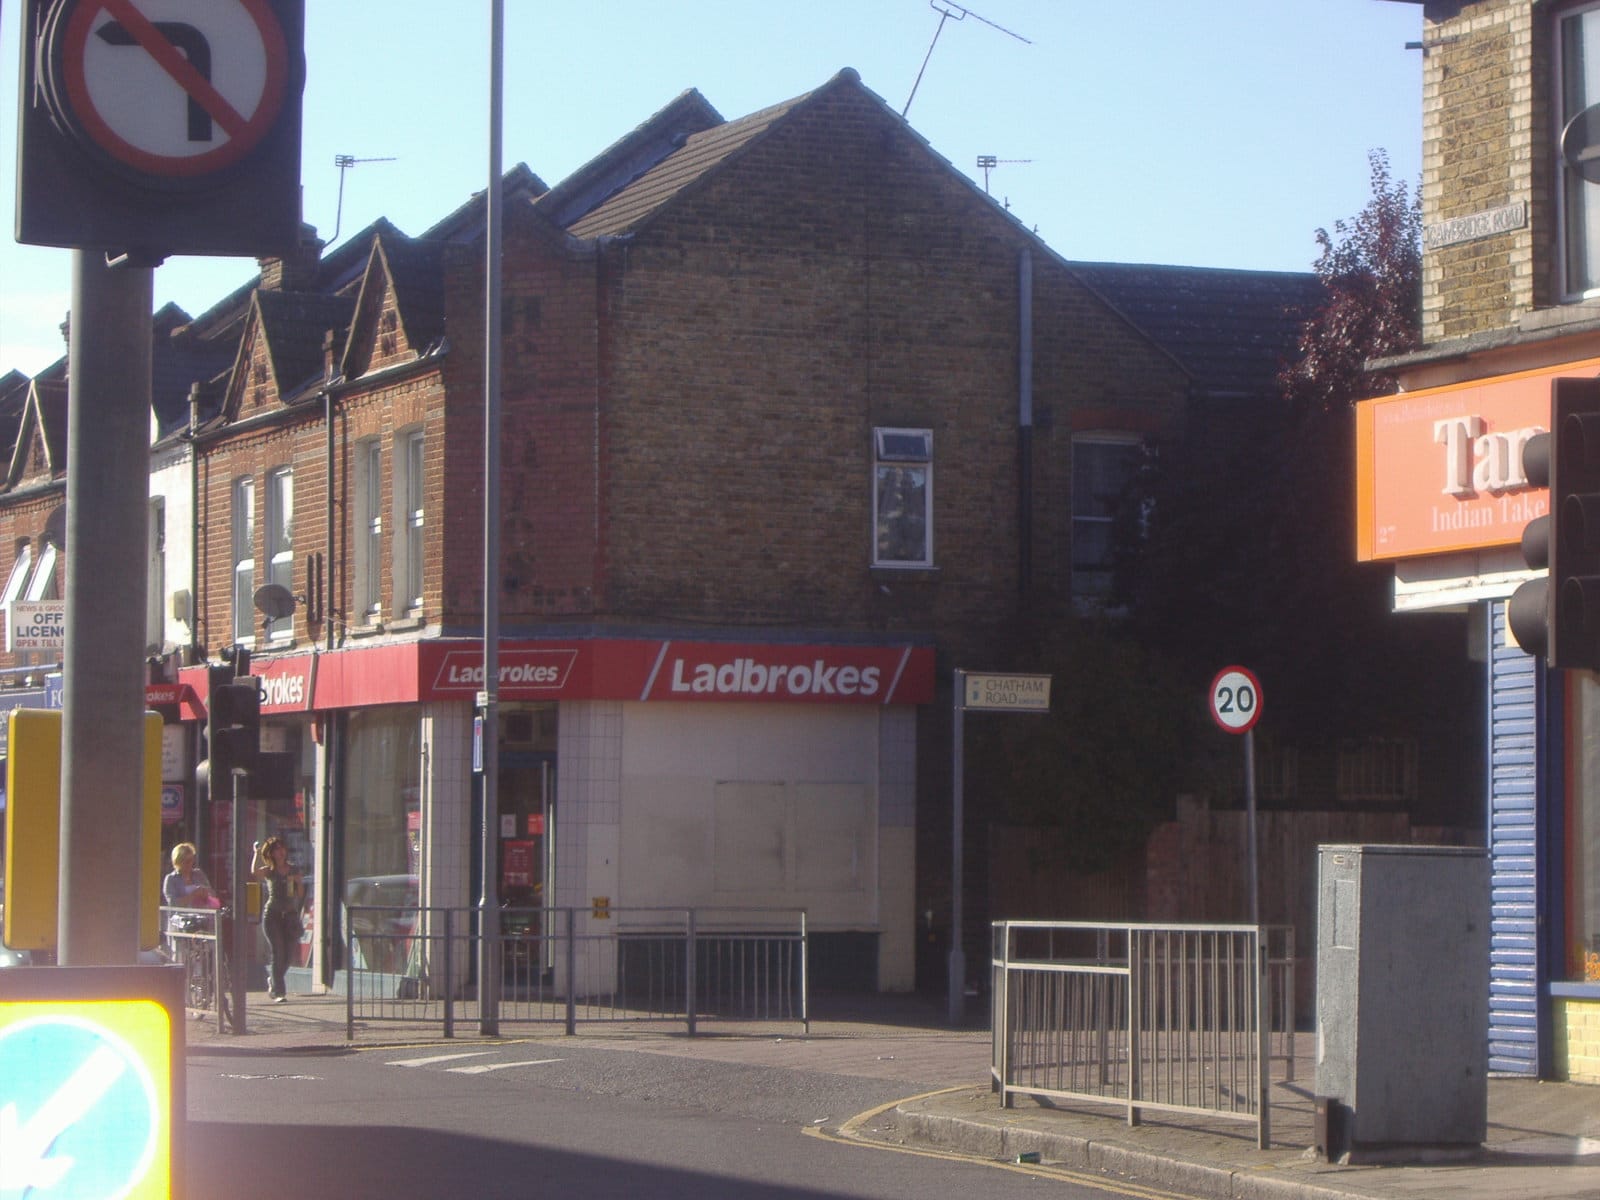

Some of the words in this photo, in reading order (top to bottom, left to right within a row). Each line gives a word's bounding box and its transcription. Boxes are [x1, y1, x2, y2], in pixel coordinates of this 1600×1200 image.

[1431, 501, 1493, 532] Indian
[33, 613, 63, 625] OFF
[16, 639, 37, 648] OPEN
[41, 639, 58, 648] TILL
[449, 663, 559, 683] Ladrokes
[671, 658, 881, 695] Ladbrokes
[986, 679, 1043, 693] CHATHAM
[985, 691, 1018, 704] ROAD
[1217, 686, 1254, 713] 20
